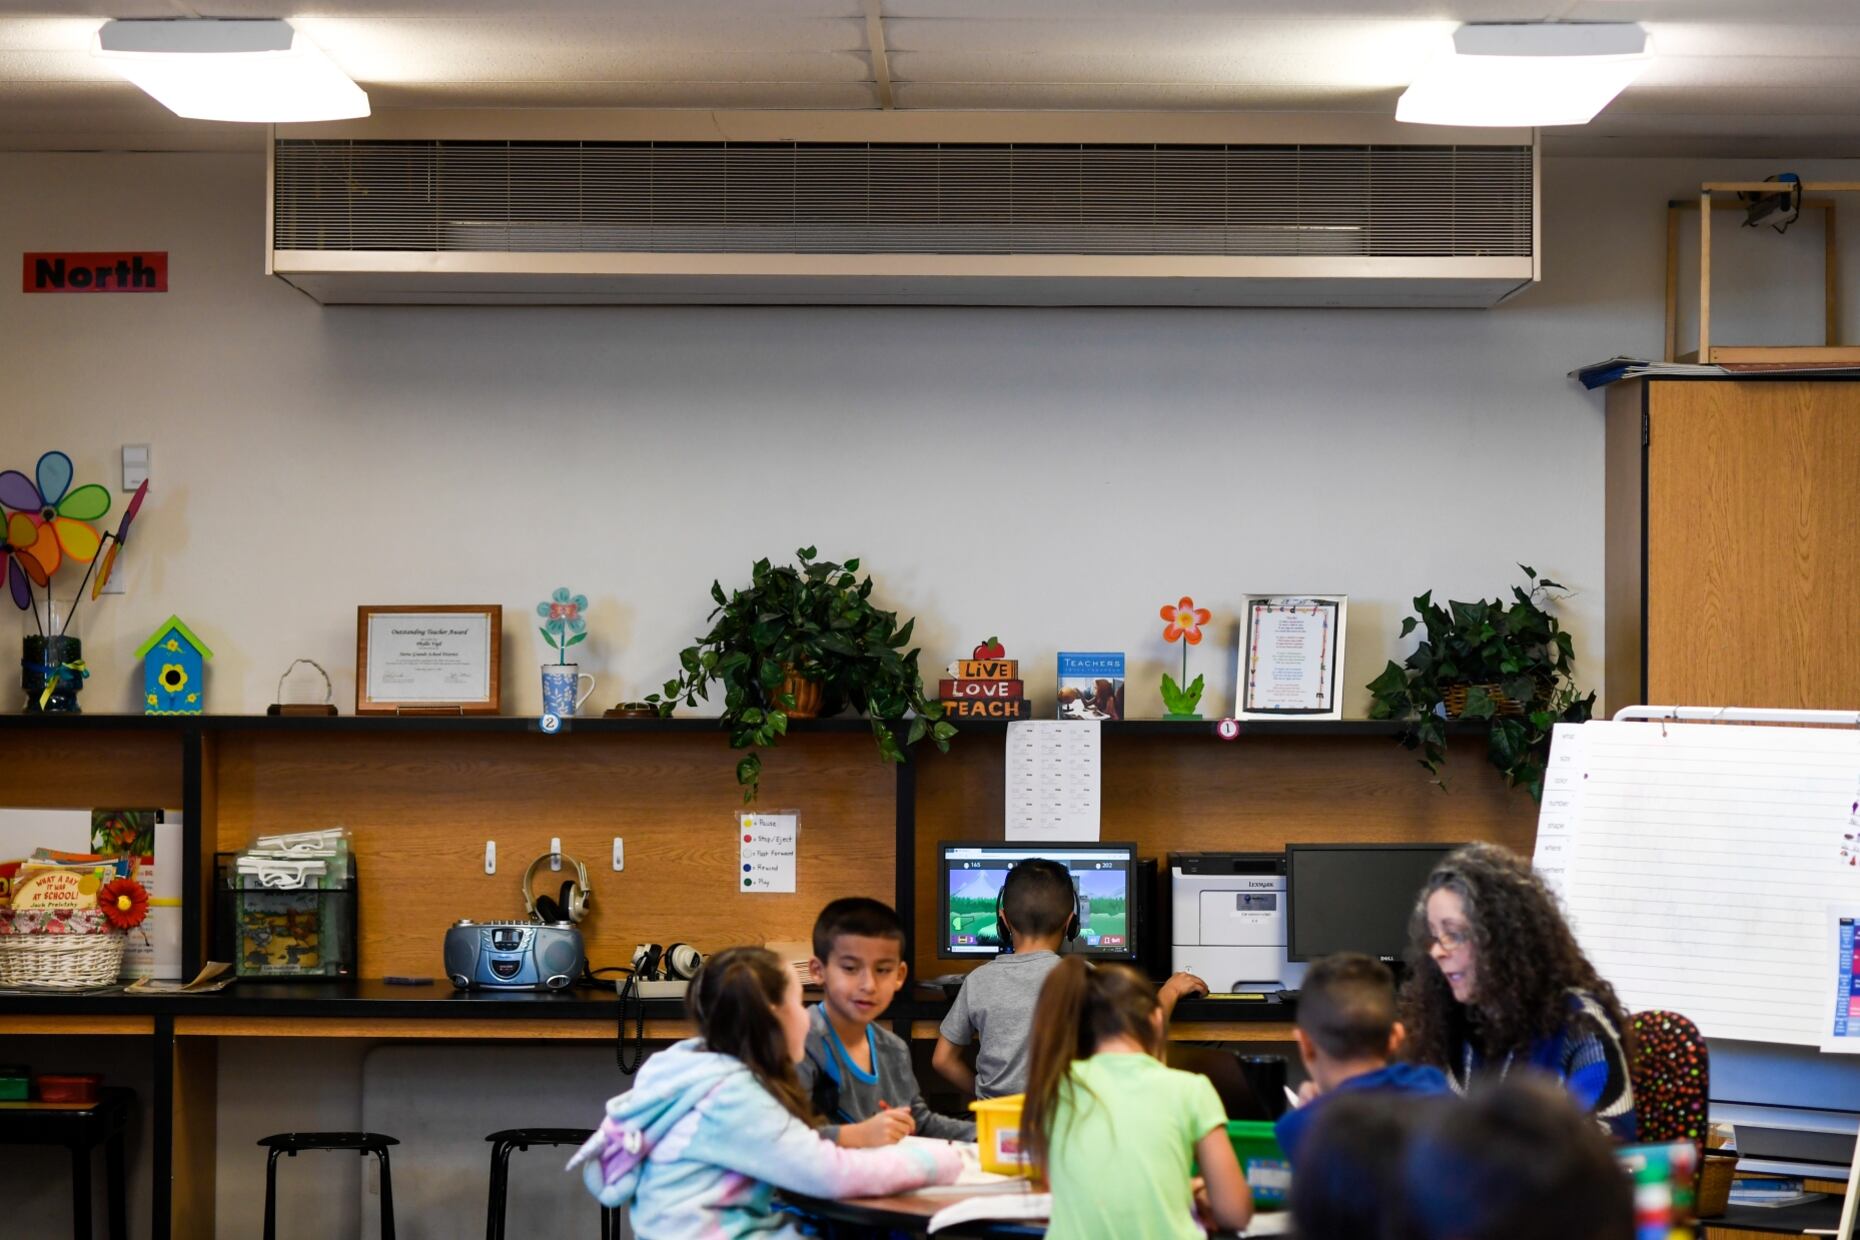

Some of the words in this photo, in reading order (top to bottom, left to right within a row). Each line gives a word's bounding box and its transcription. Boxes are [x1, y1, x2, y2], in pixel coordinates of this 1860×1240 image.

[36, 256, 156, 288] North
[391, 628, 425, 636] Outstanding
[427, 628, 448, 636] Teacher
[448, 628, 470, 636] Award
[952, 681, 1009, 697] LOVE
[942, 701, 1020, 717] TEACH
[546, 718, 554, 728] 2
[759, 819, 776, 827] Pause
[36, 875, 55, 887] WHAT
[65, 876, 78, 885] DAY
[758, 878, 770, 887] Play
[44, 891, 79, 900] SCHOOL!
